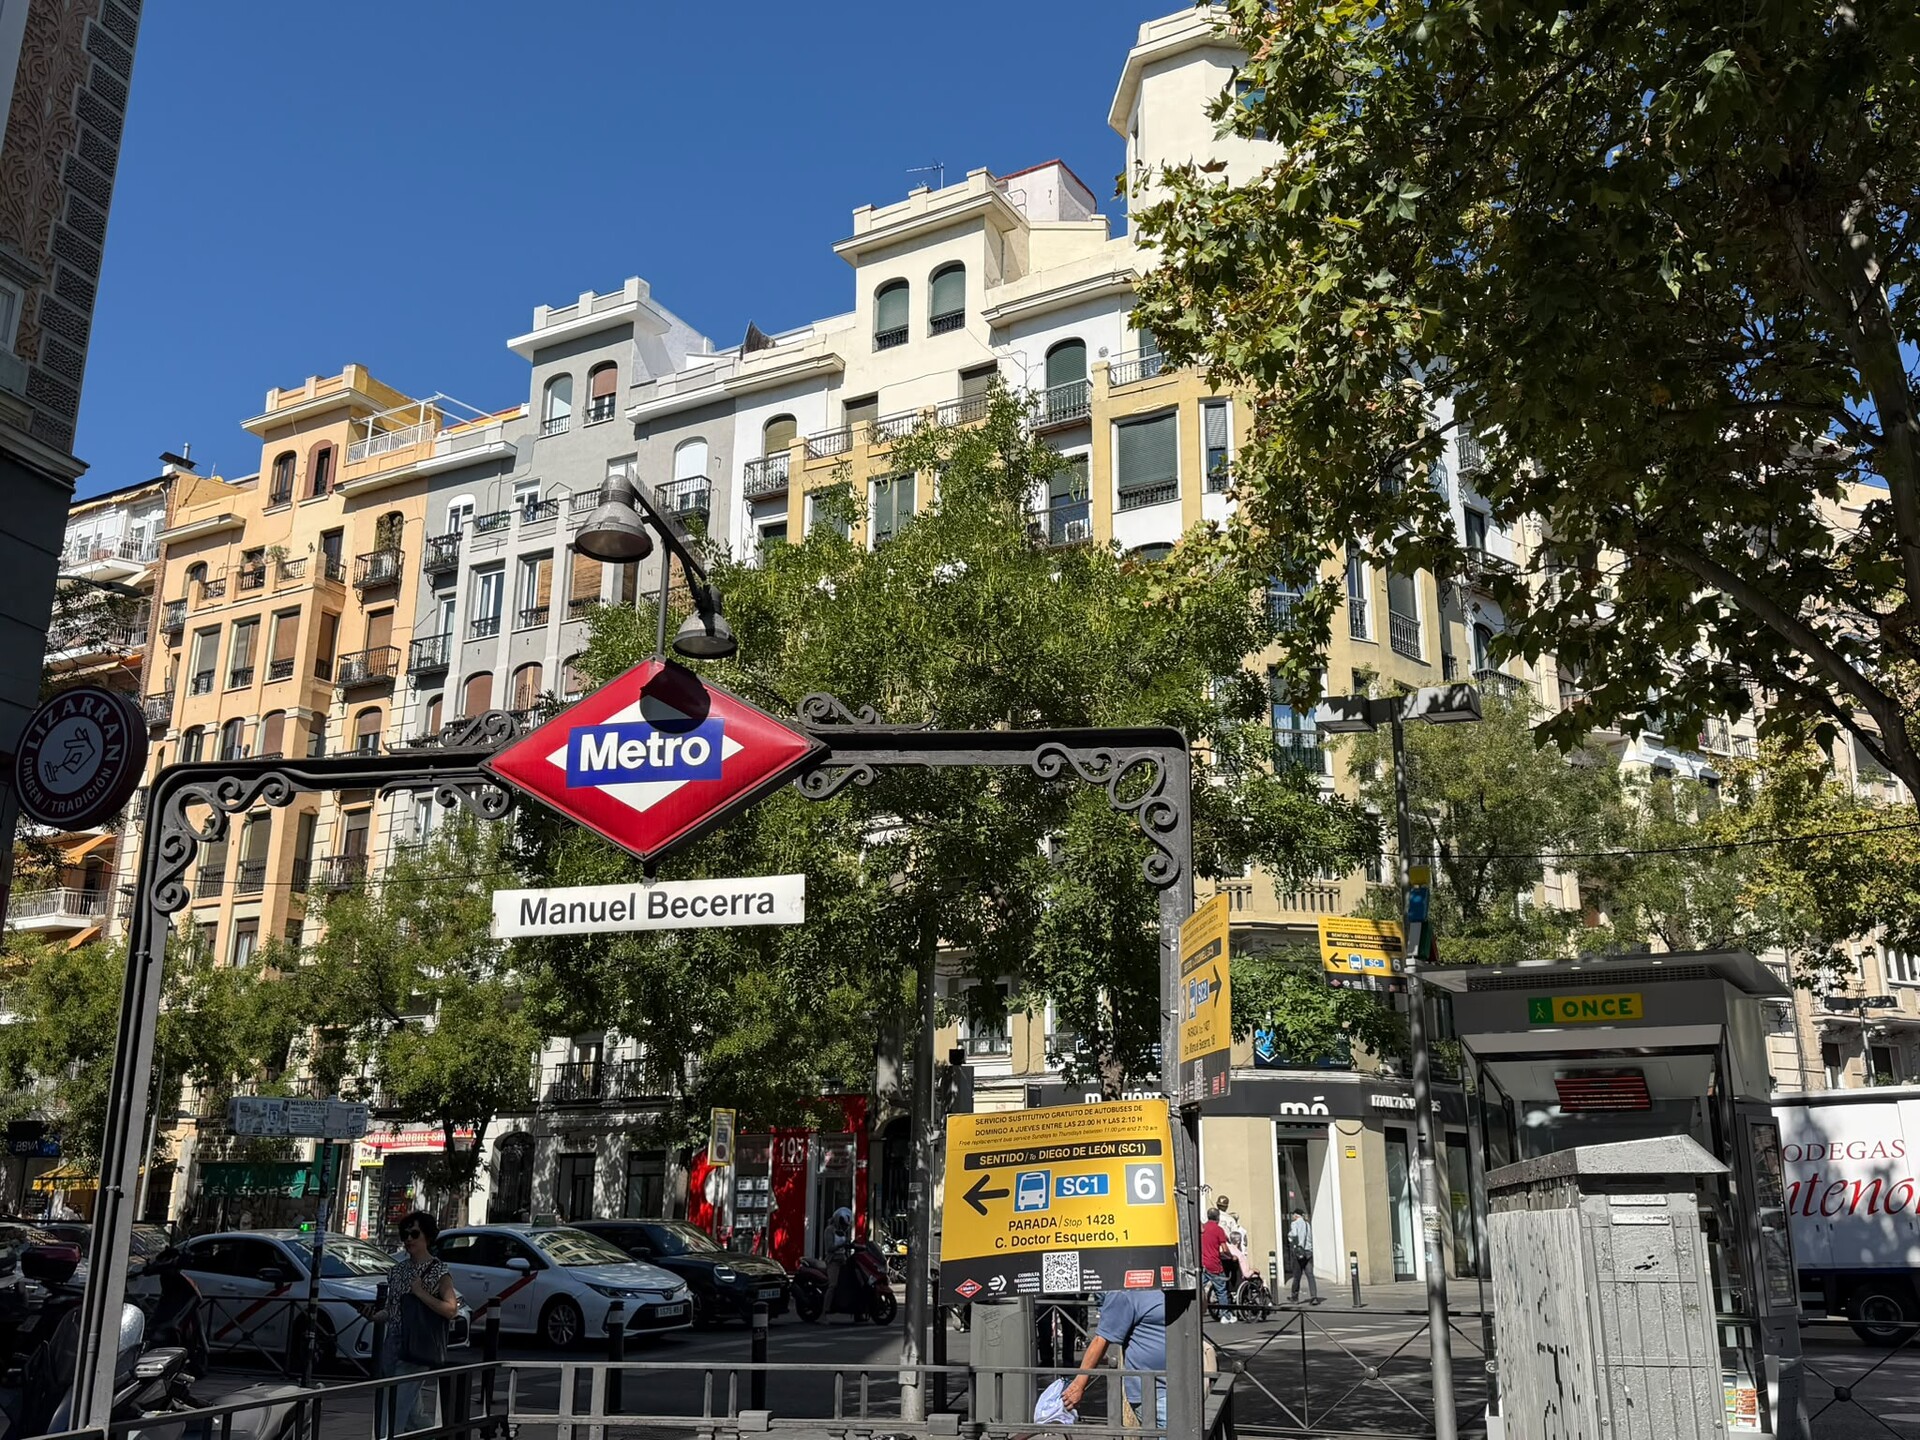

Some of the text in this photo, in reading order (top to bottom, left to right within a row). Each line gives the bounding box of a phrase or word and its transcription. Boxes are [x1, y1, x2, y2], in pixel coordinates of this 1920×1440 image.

[26, 697, 121, 760] LIZARRAN
[580, 732, 710, 772] Metro
[24, 757, 43, 805] ORIGEN
[51, 768, 112, 812] TRADICIÓN
[519, 890, 775, 926] Manuel Becerra
[1392, 958, 1400, 972] 6
[1562, 998, 1634, 1018] ONCE
[976, 1116, 1007, 1126] SERVICIO
[1008, 1112, 1050, 1122] SUSTITUTIVO
[1051, 1109, 1084, 1118] GRATUITO
[1094, 1106, 1133, 1114] AUTOBUSES
[400, 1133, 430, 1142] MOBILE
[971, 1137, 1002, 1146] replacement
[976, 1128, 1008, 1136] DOMINGO
[16, 1140, 38, 1152] BBVA
[1039, 1148, 1070, 1160] DIEGO
[1072, 1146, 1086, 1157] DE
[1089, 1143, 1115, 1155] LEÓN
[1118, 1143, 1146, 1155] (SC1)
[1782, 1139, 1906, 1162] ODEGAS
[1062, 1168, 1156, 1200] SC1 6
[1086, 1214, 1115, 1225] 1428
[995, 1230, 1129, 1248] C. Doctor Esquerdo, 1
